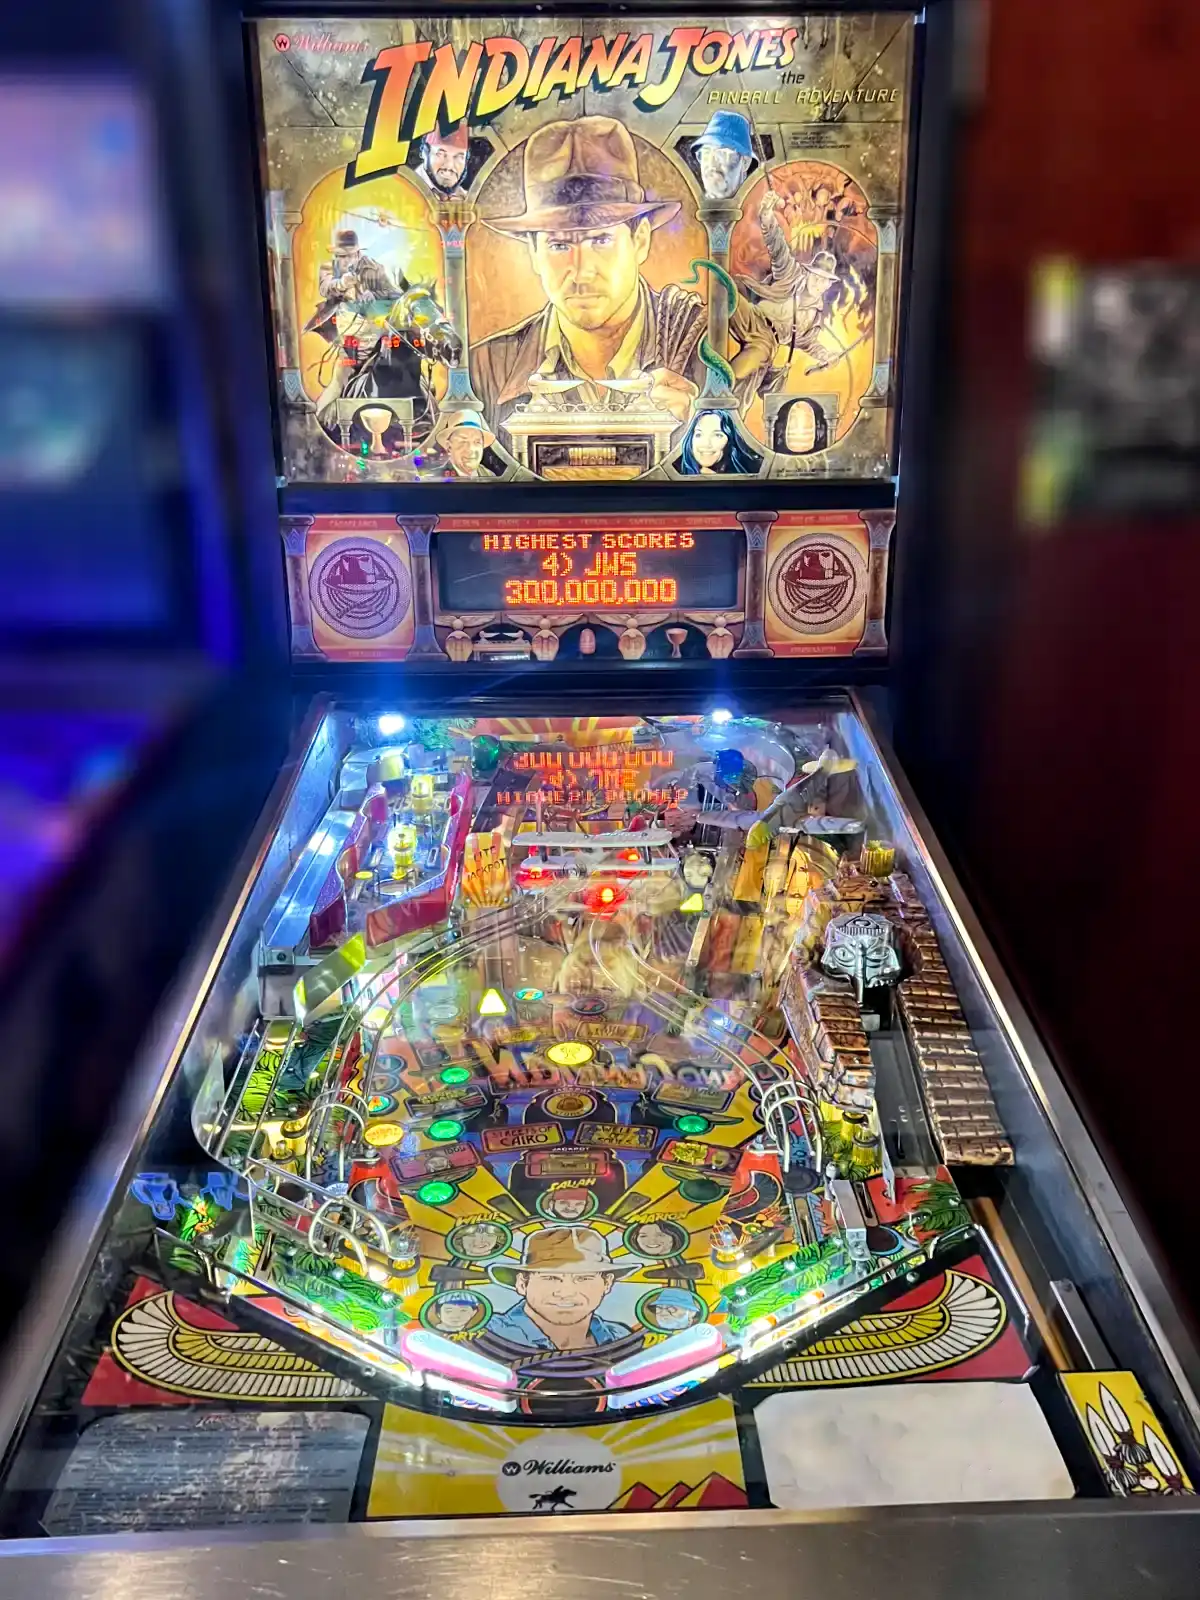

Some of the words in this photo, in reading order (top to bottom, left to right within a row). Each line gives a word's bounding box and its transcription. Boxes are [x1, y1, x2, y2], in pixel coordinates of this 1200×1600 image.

[292, 32, 369, 52] Williams
[781, 71, 804, 85] the
[707, 90, 782, 105] PINBALL
[796, 88, 899, 104] ADVENTURE
[345, 32, 652, 188] INDIANA
[636, 27, 798, 109] JONES
[483, 533, 592, 550] HIGHEST
[602, 532, 695, 549] SCORES
[542, 552, 573, 576] 4)
[584, 551, 637, 576] JWS
[505, 578, 677, 606] 300,000,000
[474, 845, 496, 861] LITE
[467, 858, 505, 882] JACKPOT
[492, 1128, 537, 1138] STREETS
[500, 1134, 549, 1147] CAIRO
[456, 1211, 501, 1226] WILLIE
[627, 1211, 688, 1224] MARION
[523, 1459, 616, 1476] Williams
